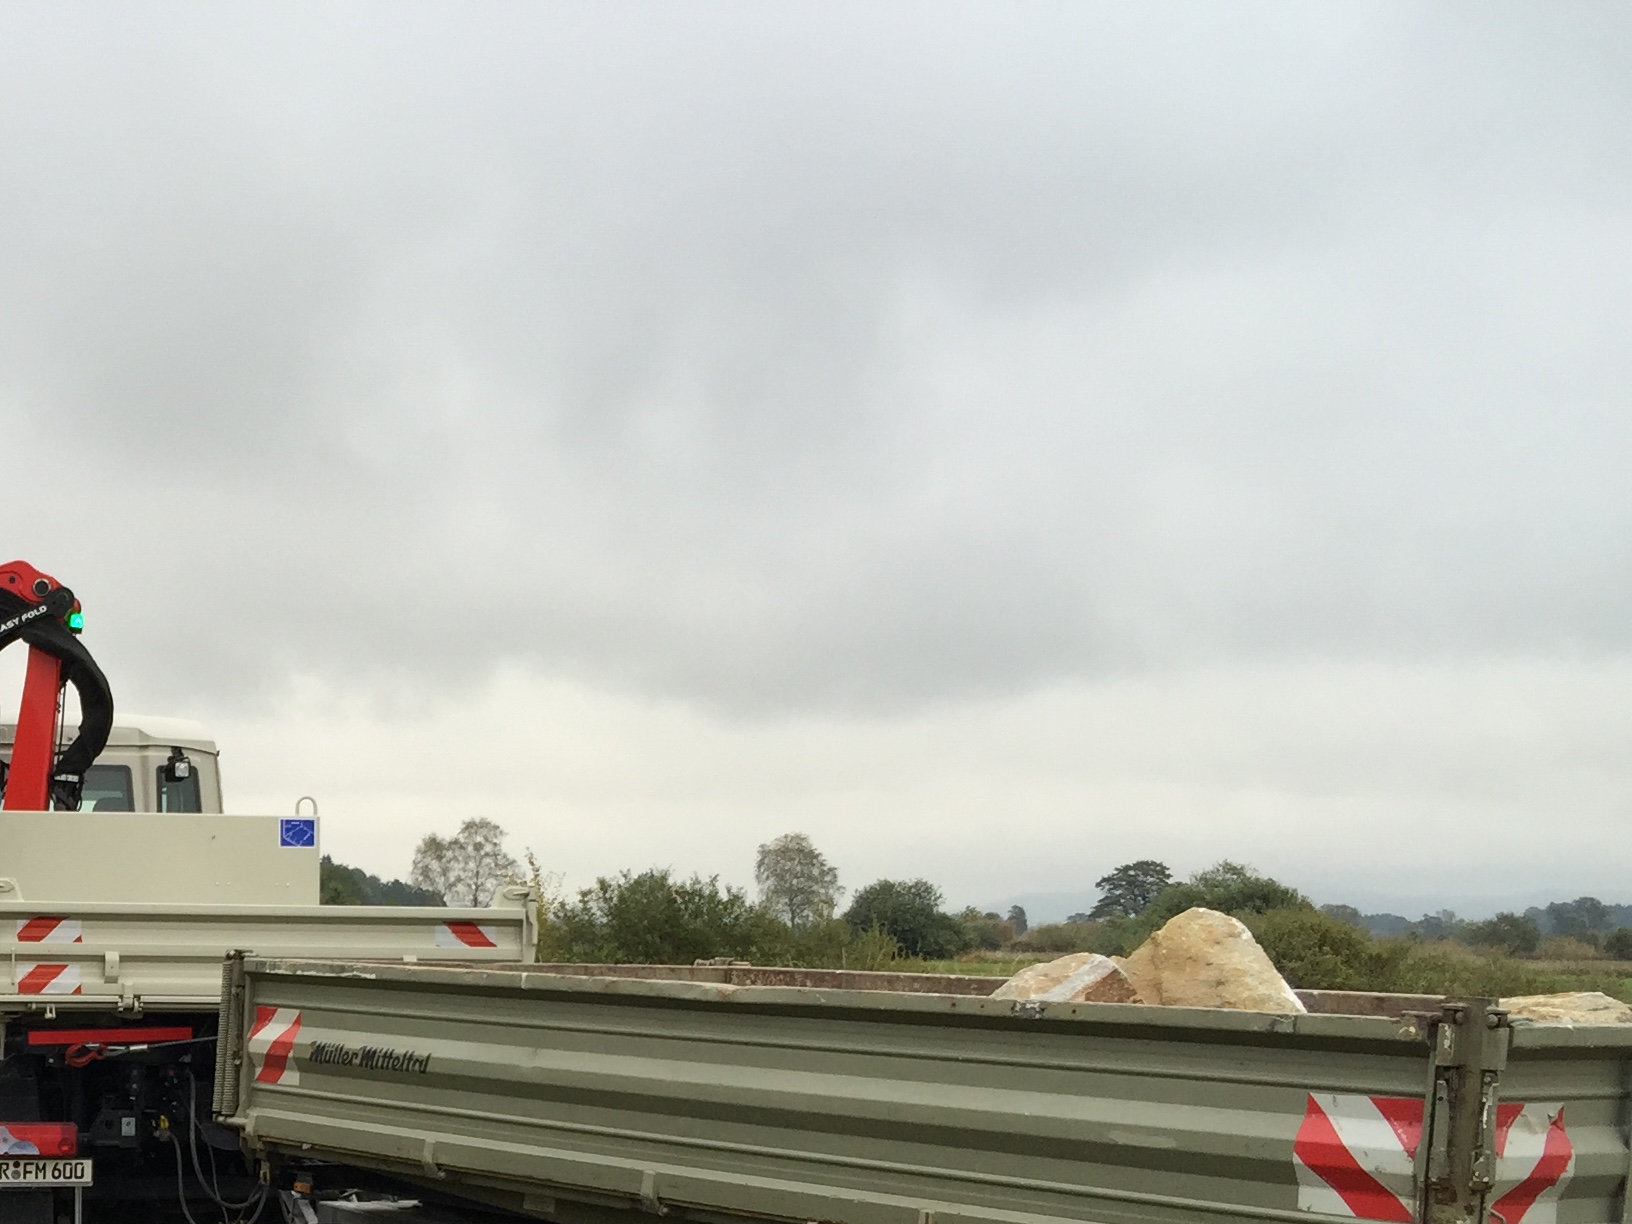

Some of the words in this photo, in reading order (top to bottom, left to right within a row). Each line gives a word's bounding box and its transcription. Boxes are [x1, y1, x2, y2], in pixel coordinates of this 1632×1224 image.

[21, 605, 47, 622] FOLD
[309, 1041, 358, 1067] Müller
[23, 1162, 47, 1180] FM
[52, 1162, 84, 1180] 600
